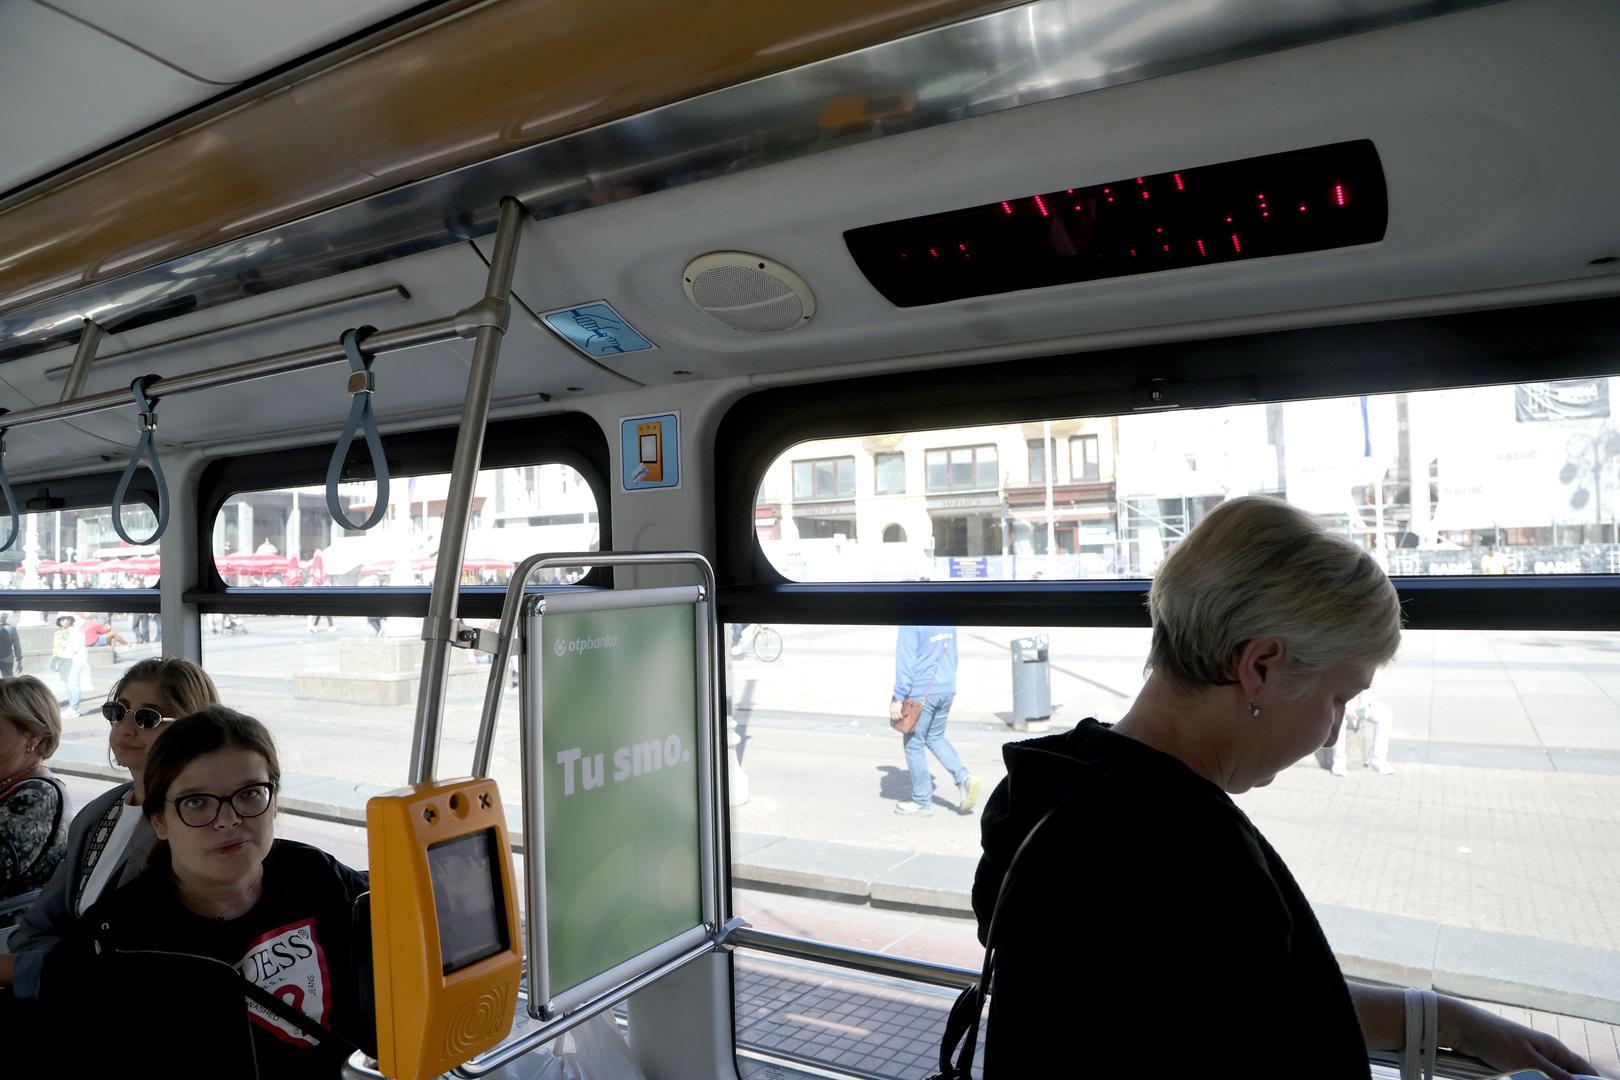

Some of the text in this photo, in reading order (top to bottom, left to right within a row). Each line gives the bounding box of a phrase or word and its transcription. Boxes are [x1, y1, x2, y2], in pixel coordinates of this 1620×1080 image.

[569, 634, 618, 655] otpbanka
[556, 734, 690, 796] Tu smo.
[306, 974, 317, 997] JEANS
